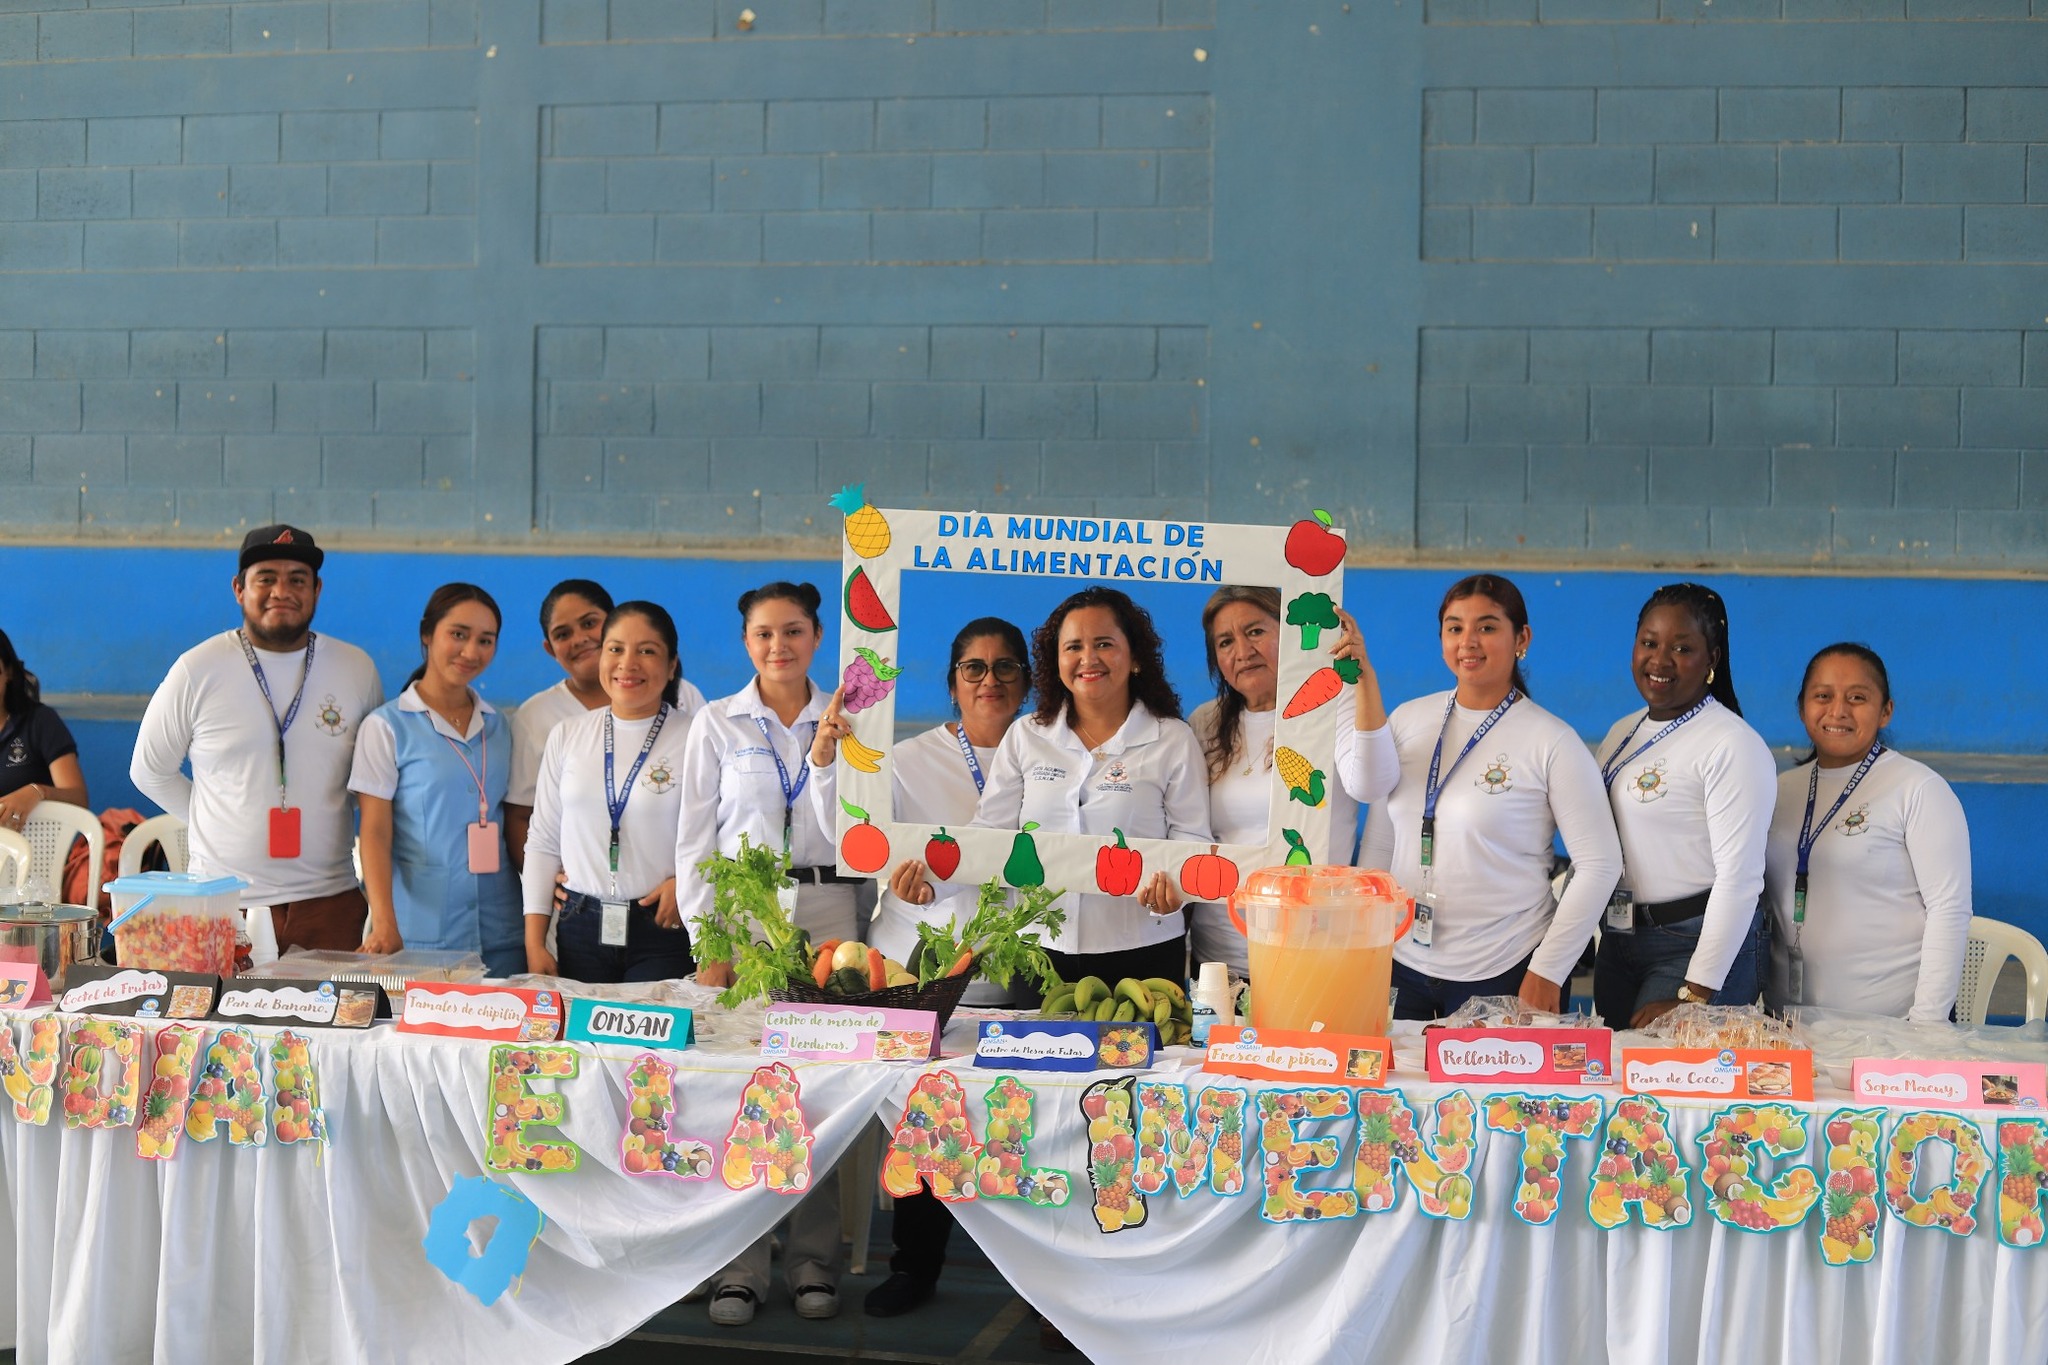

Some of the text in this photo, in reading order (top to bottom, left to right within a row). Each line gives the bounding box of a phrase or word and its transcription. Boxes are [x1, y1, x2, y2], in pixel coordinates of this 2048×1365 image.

[1007, 517, 1152, 544] MUNDIAL
[1164, 524, 1204, 548] DE
[914, 545, 1222, 581] LA ALIMENTACIÓN
[1473, 701, 1510, 741] BARRIOS
[642, 713, 664, 753] BARRIOS
[958, 731, 979, 772] BARRIOS
[1843, 755, 1876, 795] BARRIOS
[103, 986, 116, 998] de
[121, 979, 167, 995] Frutas.
[225, 996, 329, 1014] Pan de Banano.
[409, 995, 458, 1013] Tamales
[461, 1002, 474, 1015] de
[592, 1011, 671, 1038] OMSAN
[766, 1012, 881, 1028] Centro de mesa de
[790, 1036, 849, 1050] Verduras.
[980, 1046, 1009, 1054] Centro
[1023, 1046, 1046, 1055] Mesa
[1046, 1047, 1056, 1055] de
[1211, 1047, 1333, 1069] Fresco de piña.
[1443, 1049, 1533, 1066] Rellenitos.
[1630, 1071, 1725, 1085] Pan de Coco.
[1864, 1078, 1959, 1098] Sopa Macuy.
[618, 1052, 816, 1196] LA
